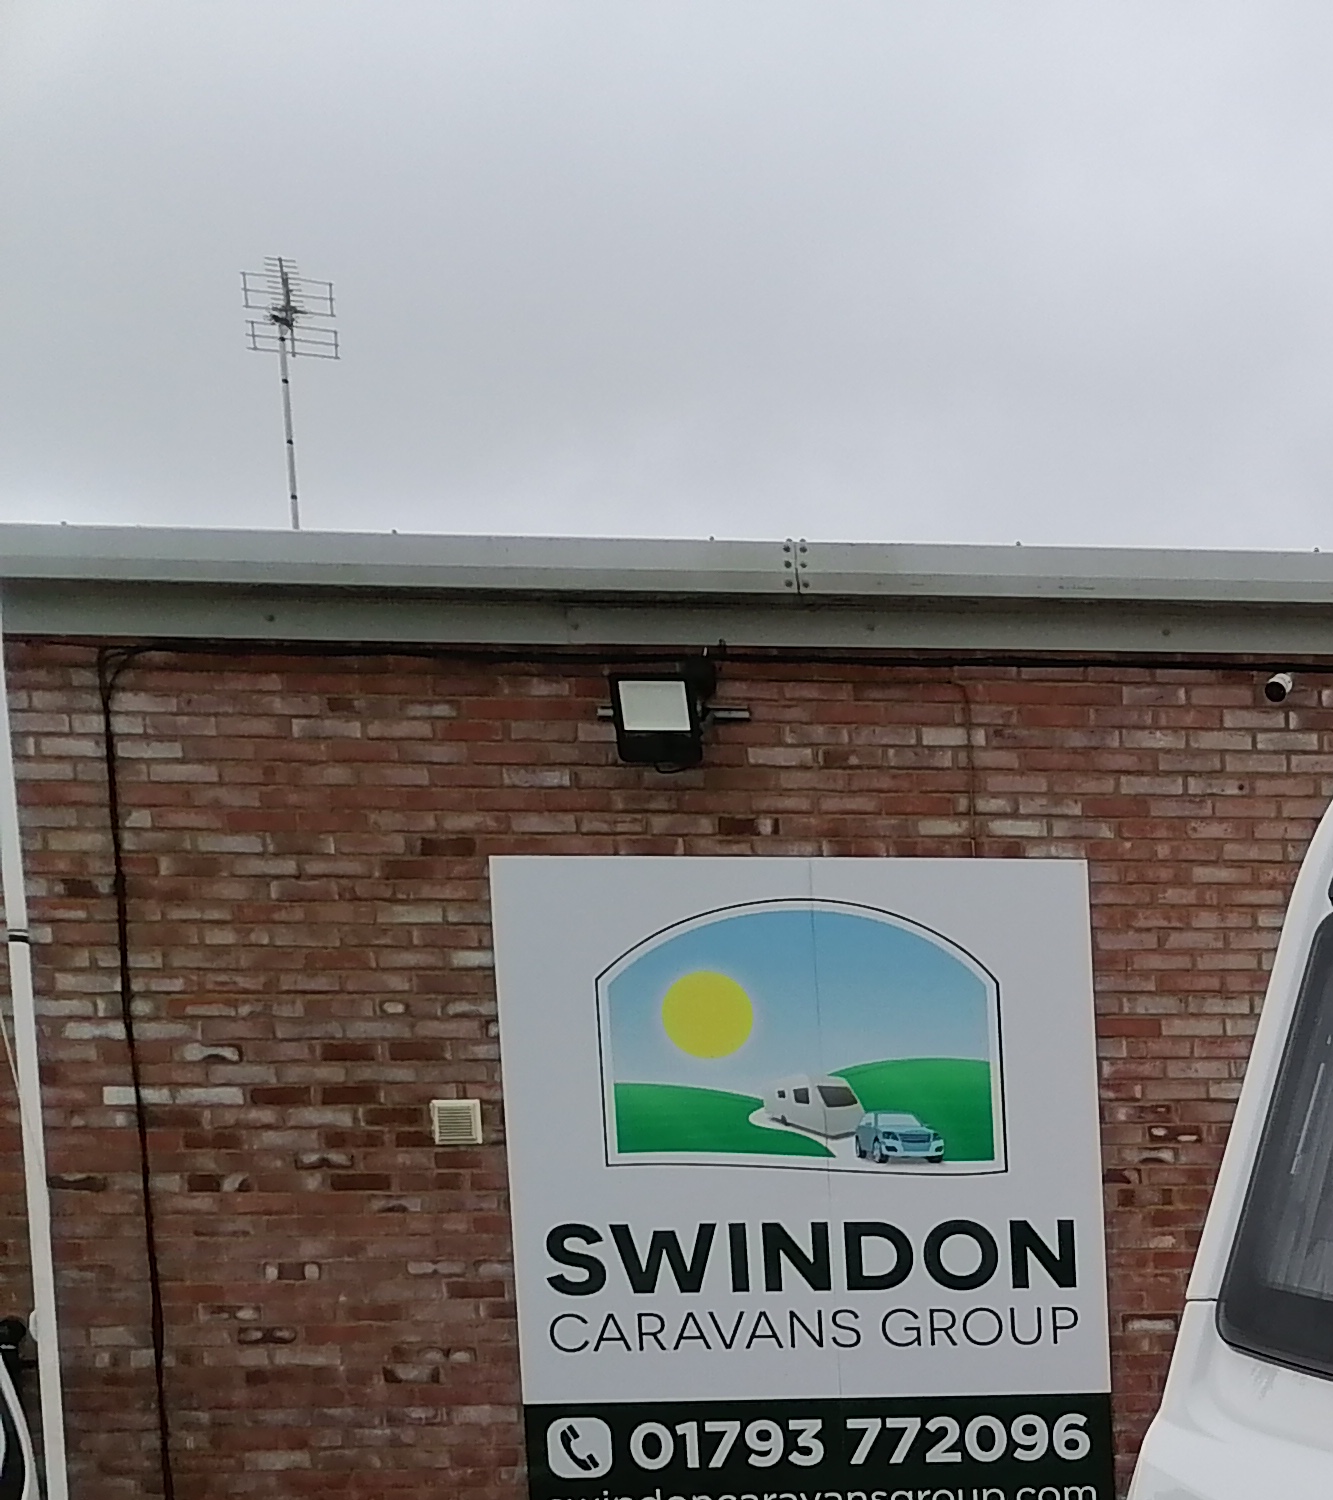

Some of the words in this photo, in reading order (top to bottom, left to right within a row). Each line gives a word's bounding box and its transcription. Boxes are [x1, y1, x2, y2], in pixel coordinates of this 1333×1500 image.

[546, 1219, 1078, 1296] SWINDON
[549, 1309, 861, 1353] CARAVANS
[881, 1307, 1079, 1348] GROUP
[629, 1418, 824, 1471] 01793
[846, 1413, 1091, 1466] 772096
